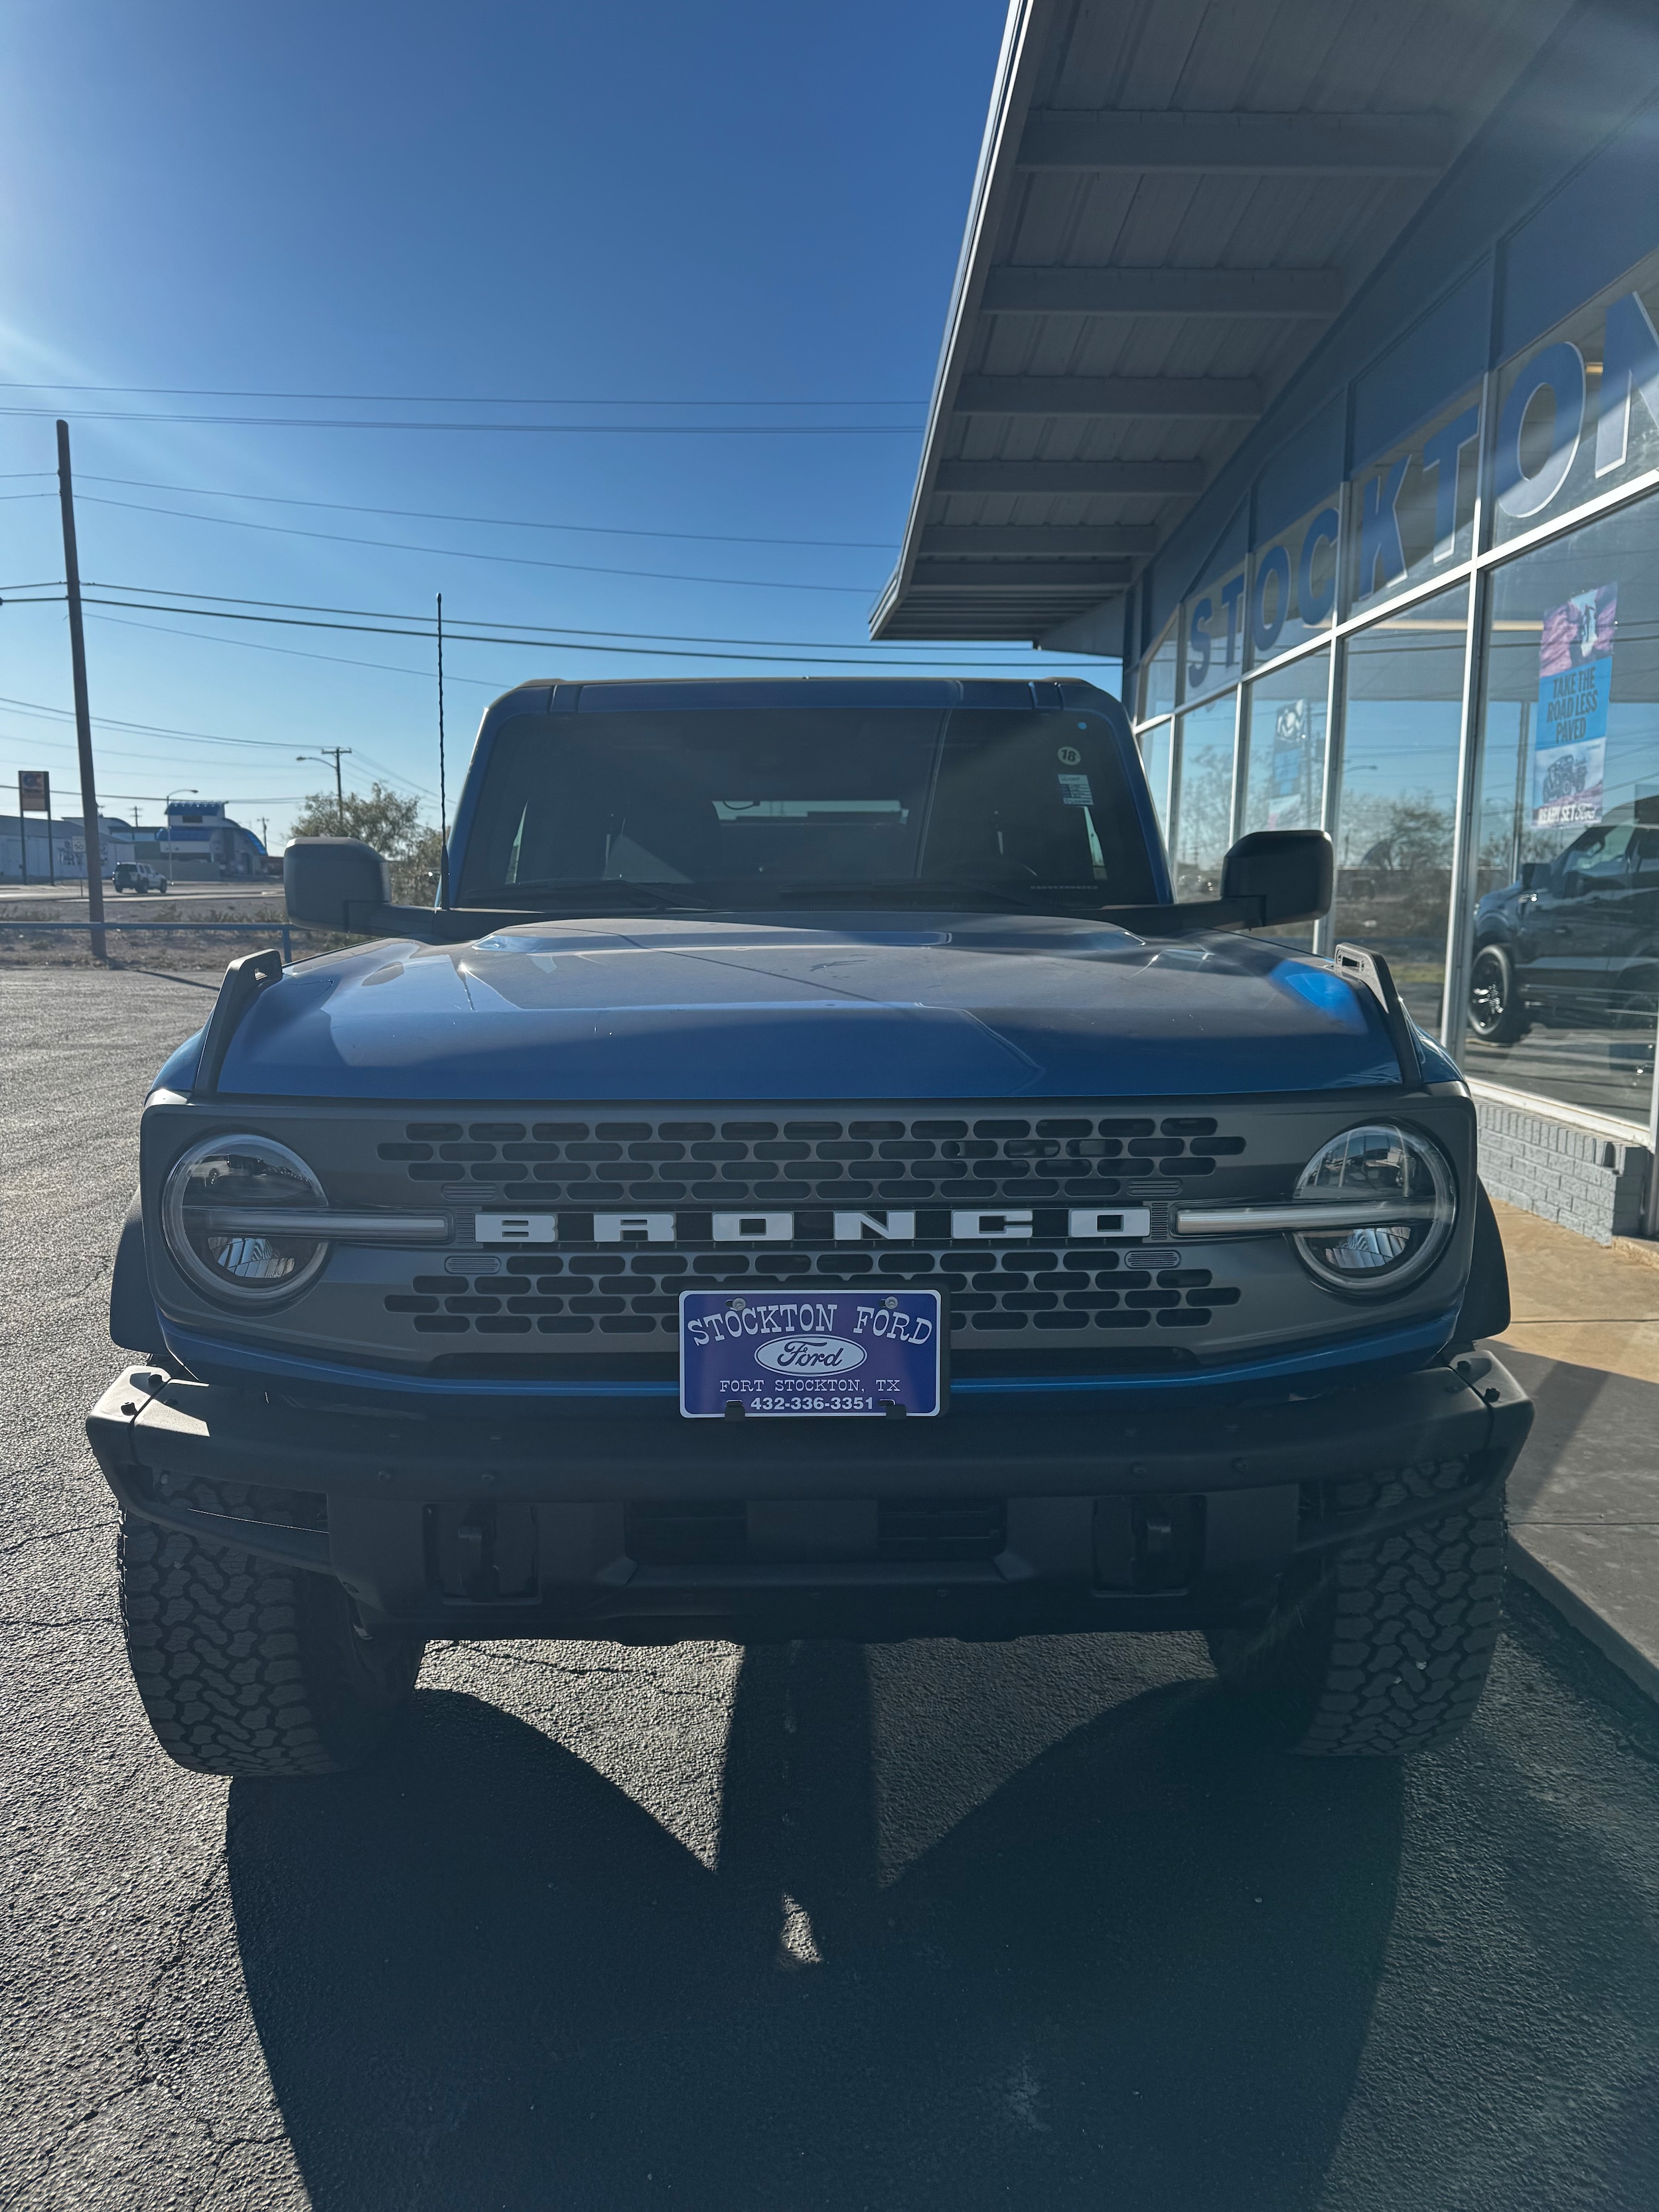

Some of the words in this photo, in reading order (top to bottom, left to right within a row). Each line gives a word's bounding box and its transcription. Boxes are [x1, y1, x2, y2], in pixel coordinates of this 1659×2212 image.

[1553, 672, 1577, 699] TAKE
[1578, 666, 1596, 692] THE
[1547, 696, 1573, 723] ROAD
[1575, 690, 1598, 716] LESS
[1556, 717, 1586, 743] PAVED
[1561, 804, 1576, 822] SET
[474, 1207, 1151, 1243] BRONCO
[687, 1303, 837, 1347] STOCKTON
[853, 1306, 933, 1345] FORD
[777, 1341, 844, 1367] Ford
[720, 1380, 764, 1392] FORT
[775, 1379, 865, 1393] STOCKTON,
[876, 1379, 901, 1392] TX
[751, 1397, 873, 1410] 432-336-3351
